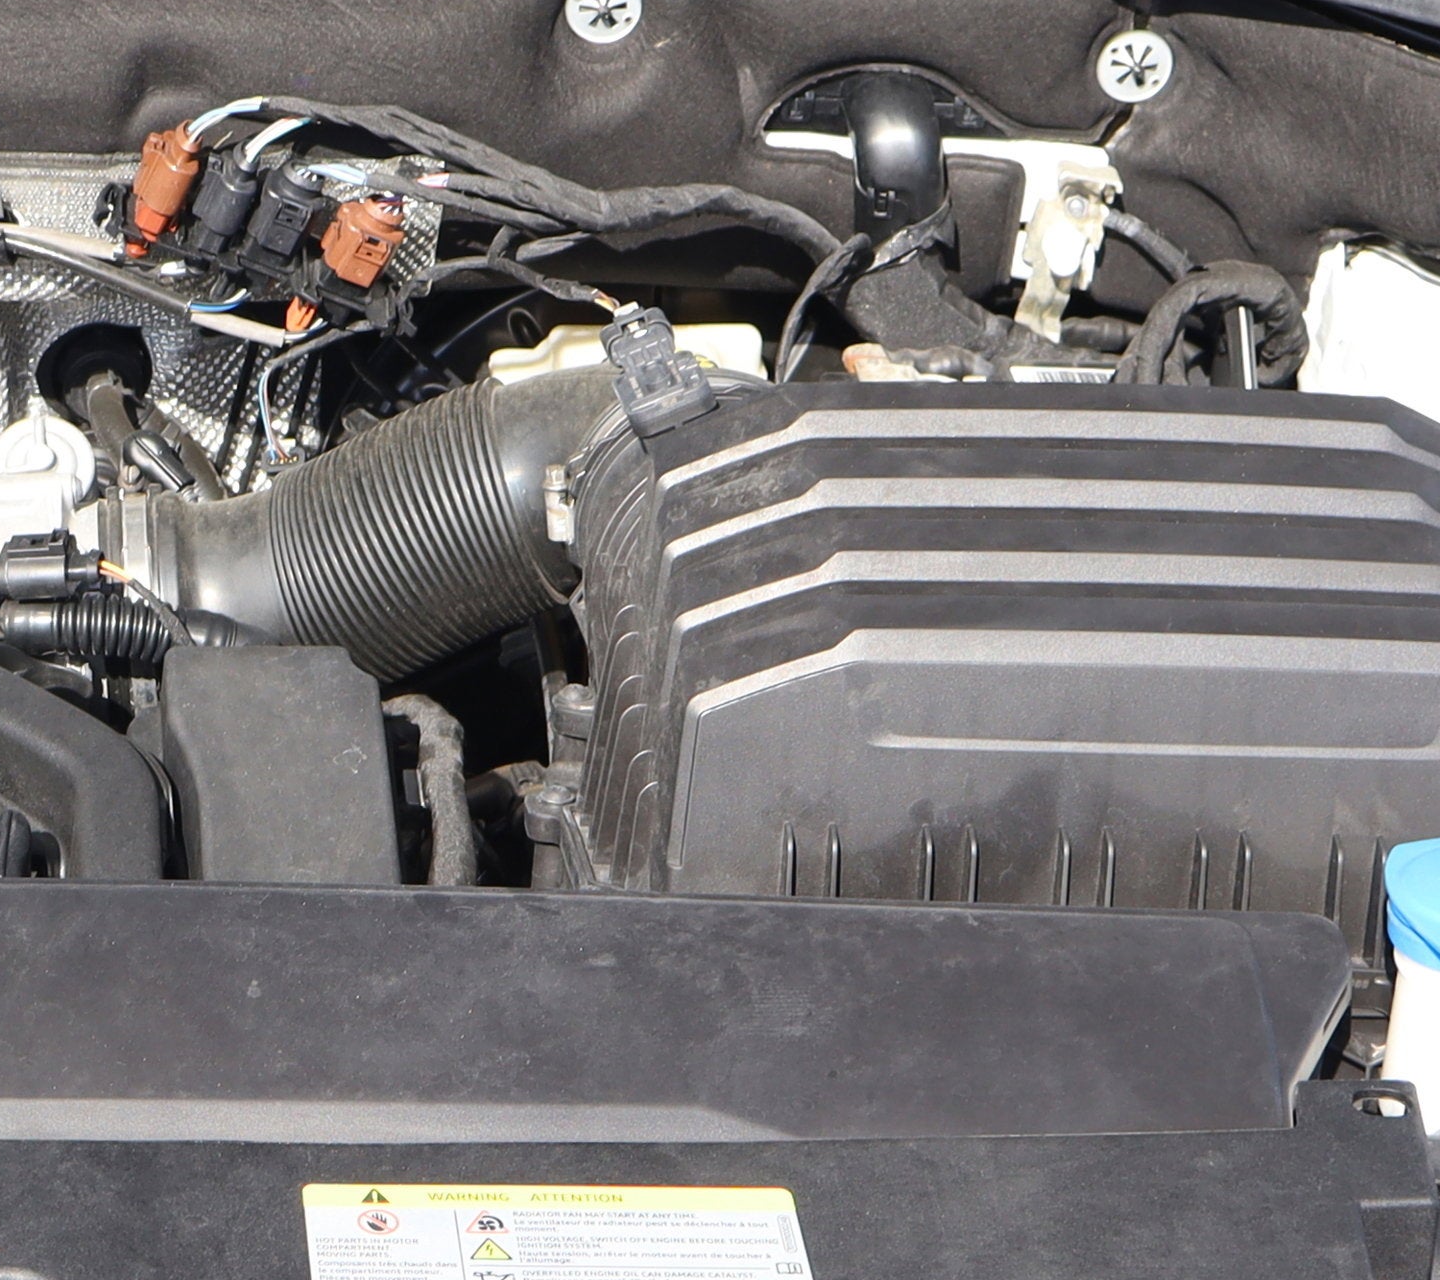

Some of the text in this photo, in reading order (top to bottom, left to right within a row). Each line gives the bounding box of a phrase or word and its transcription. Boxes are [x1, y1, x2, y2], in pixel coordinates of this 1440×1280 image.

[427, 1192, 623, 1203] WARNING ATTENTION
[512, 1210, 560, 1218] RADIATOR
[317, 1260, 377, 1268] Composants
[330, 1267, 402, 1276] compartiment
